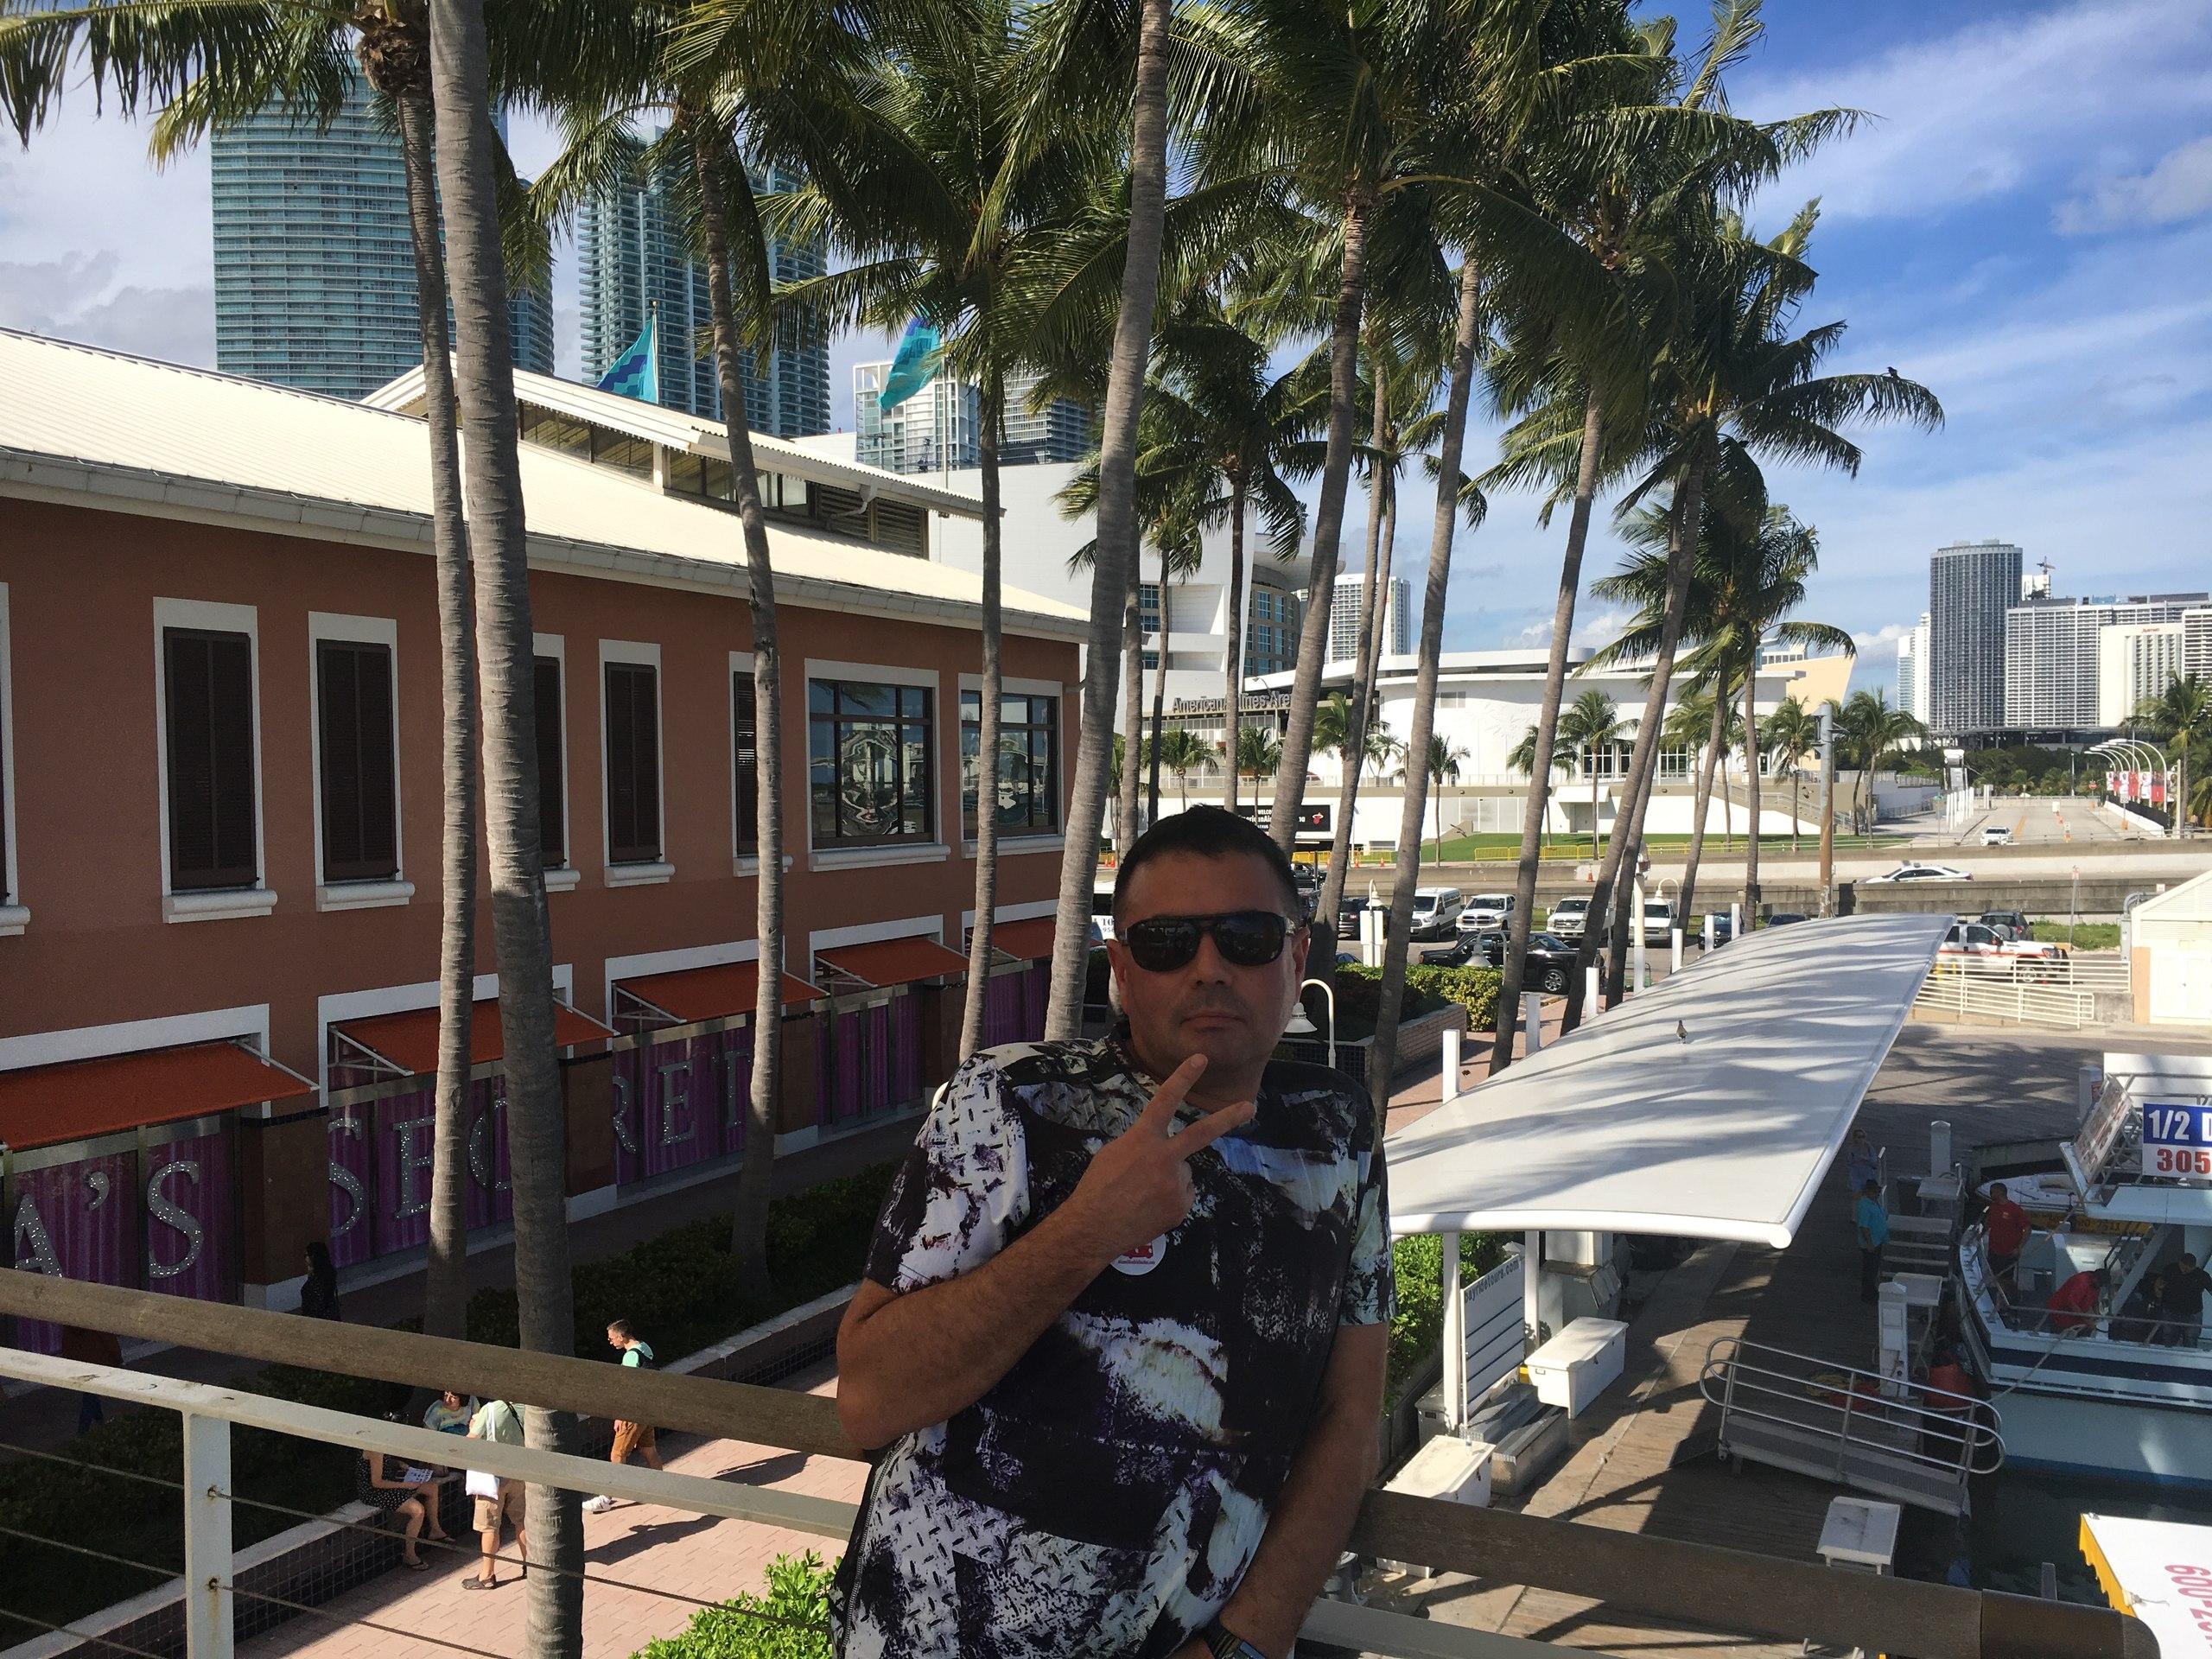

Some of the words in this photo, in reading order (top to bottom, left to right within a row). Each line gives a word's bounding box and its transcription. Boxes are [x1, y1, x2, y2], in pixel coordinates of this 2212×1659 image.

[1271, 690, 1291, 708] Are
[2150, 1110, 2190, 1141] 1/2
[2157, 1148, 2211, 1174] 305
